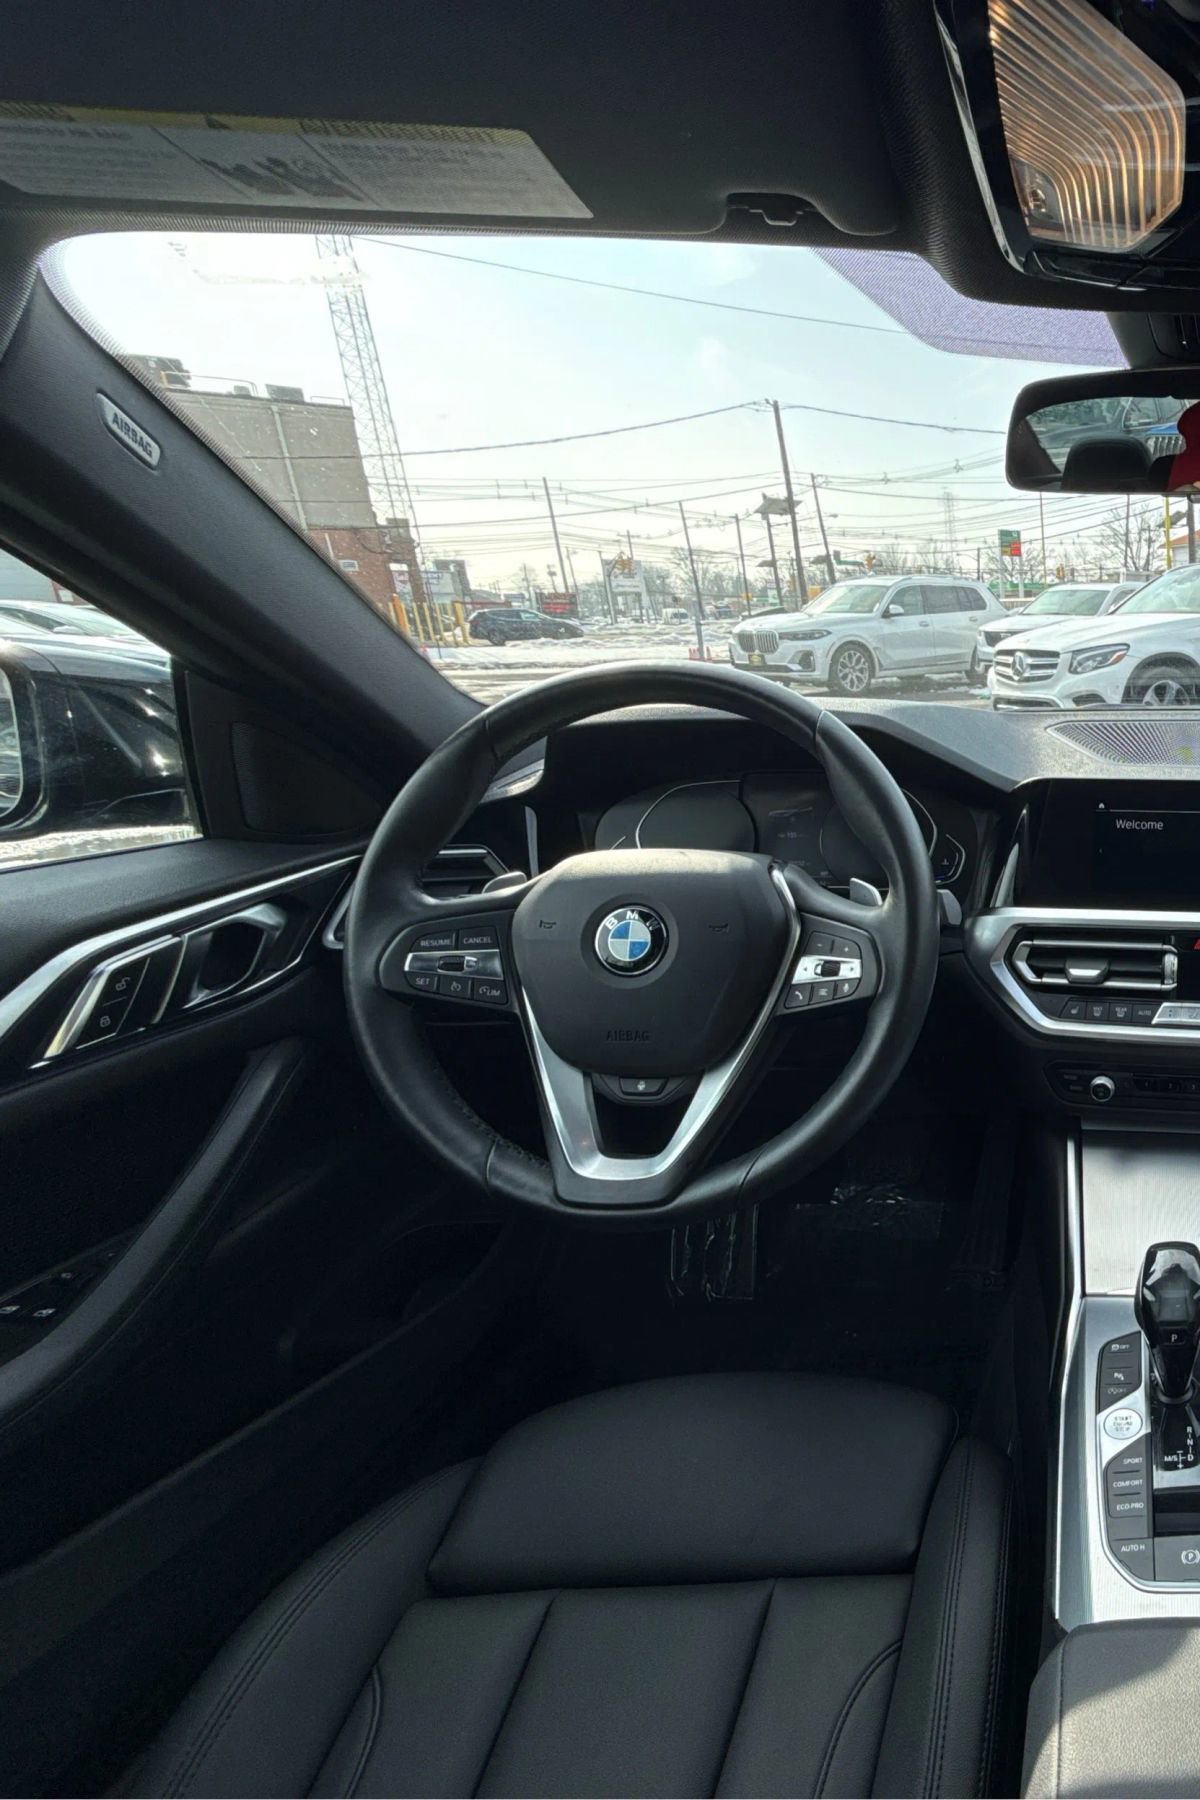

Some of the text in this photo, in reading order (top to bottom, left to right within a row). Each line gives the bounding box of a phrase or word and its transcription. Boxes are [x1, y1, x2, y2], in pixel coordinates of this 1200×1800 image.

[112, 412, 154, 459] AIRBAG
[1115, 819, 1164, 830] Welcome
[605, 910, 660, 931] BMW
[420, 938, 452, 947] RESUME
[463, 936, 492, 944] CANCEL
[606, 1030, 650, 1041] AIRBAG
[1171, 1334, 1178, 1342] P
[1112, 1479, 1142, 1488] COMFORT
[1116, 1503, 1130, 1511] ECO
